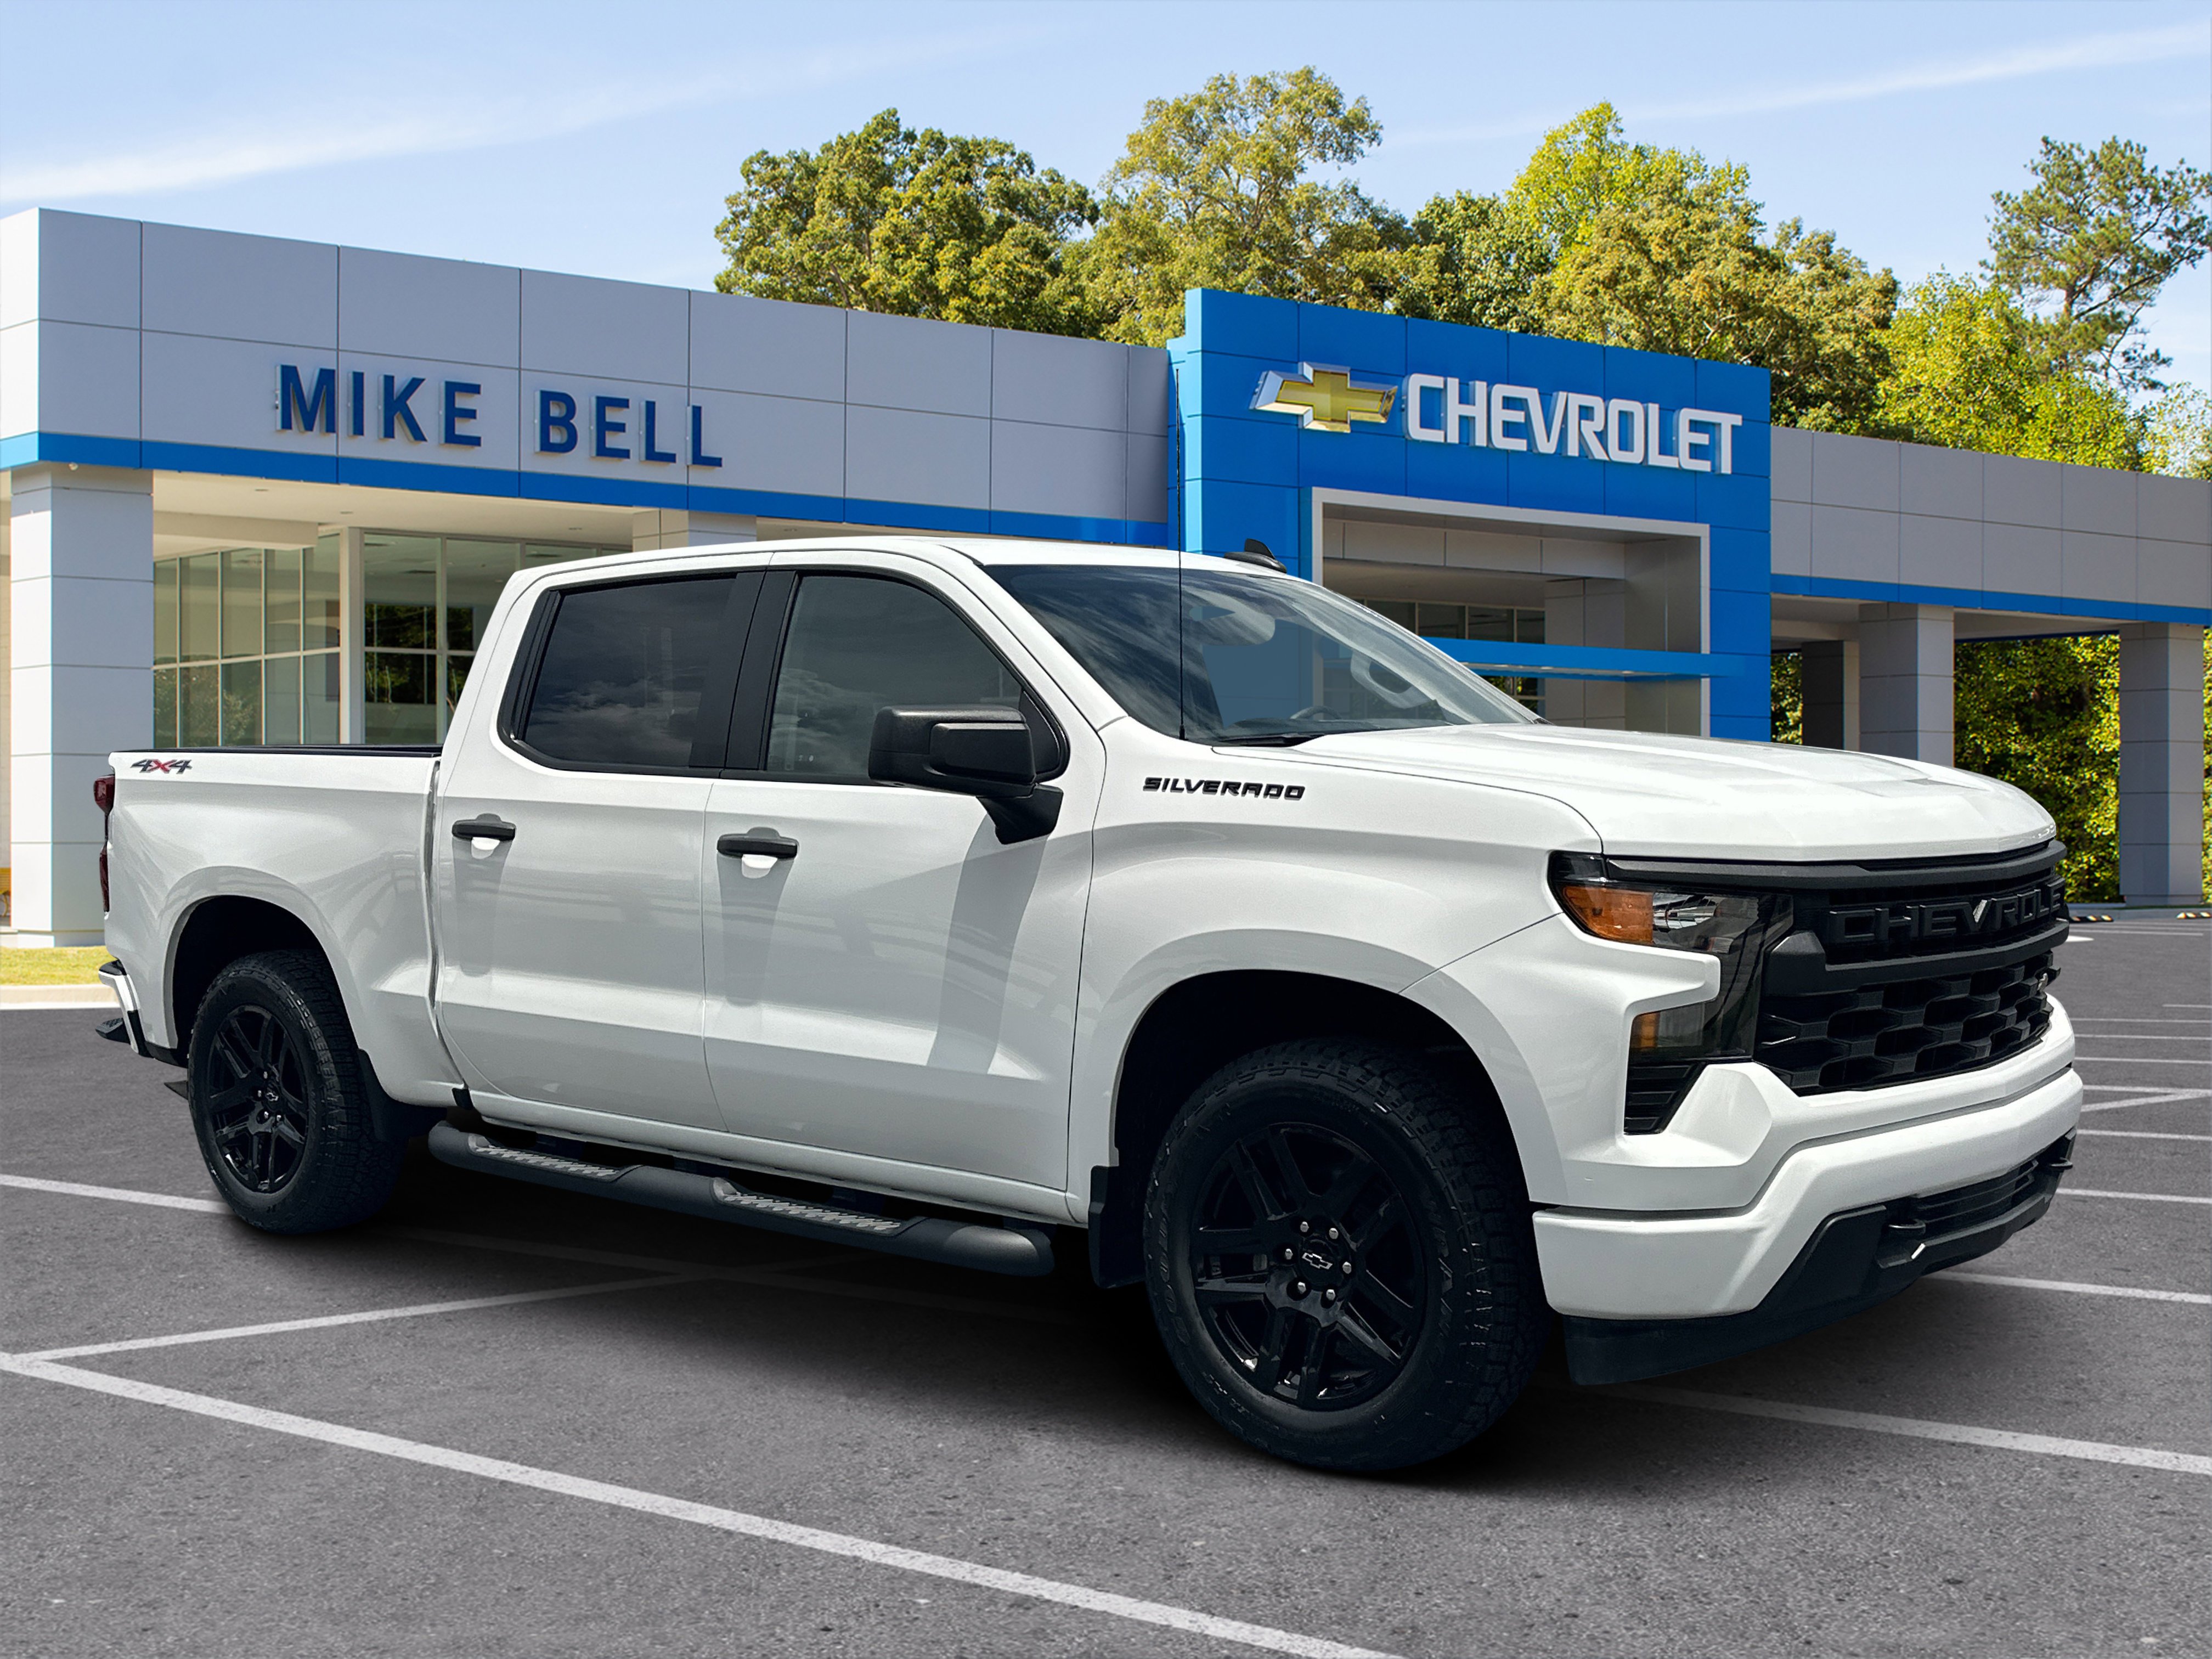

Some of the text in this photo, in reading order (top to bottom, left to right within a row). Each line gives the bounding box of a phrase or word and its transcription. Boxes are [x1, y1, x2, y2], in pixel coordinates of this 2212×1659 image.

[275, 364, 723, 467] MIKE BELL
[1401, 373, 1743, 475] CHEVROLET
[1143, 777, 1306, 801] SILVERADO
[1829, 877, 2066, 943] CHEVROLE
